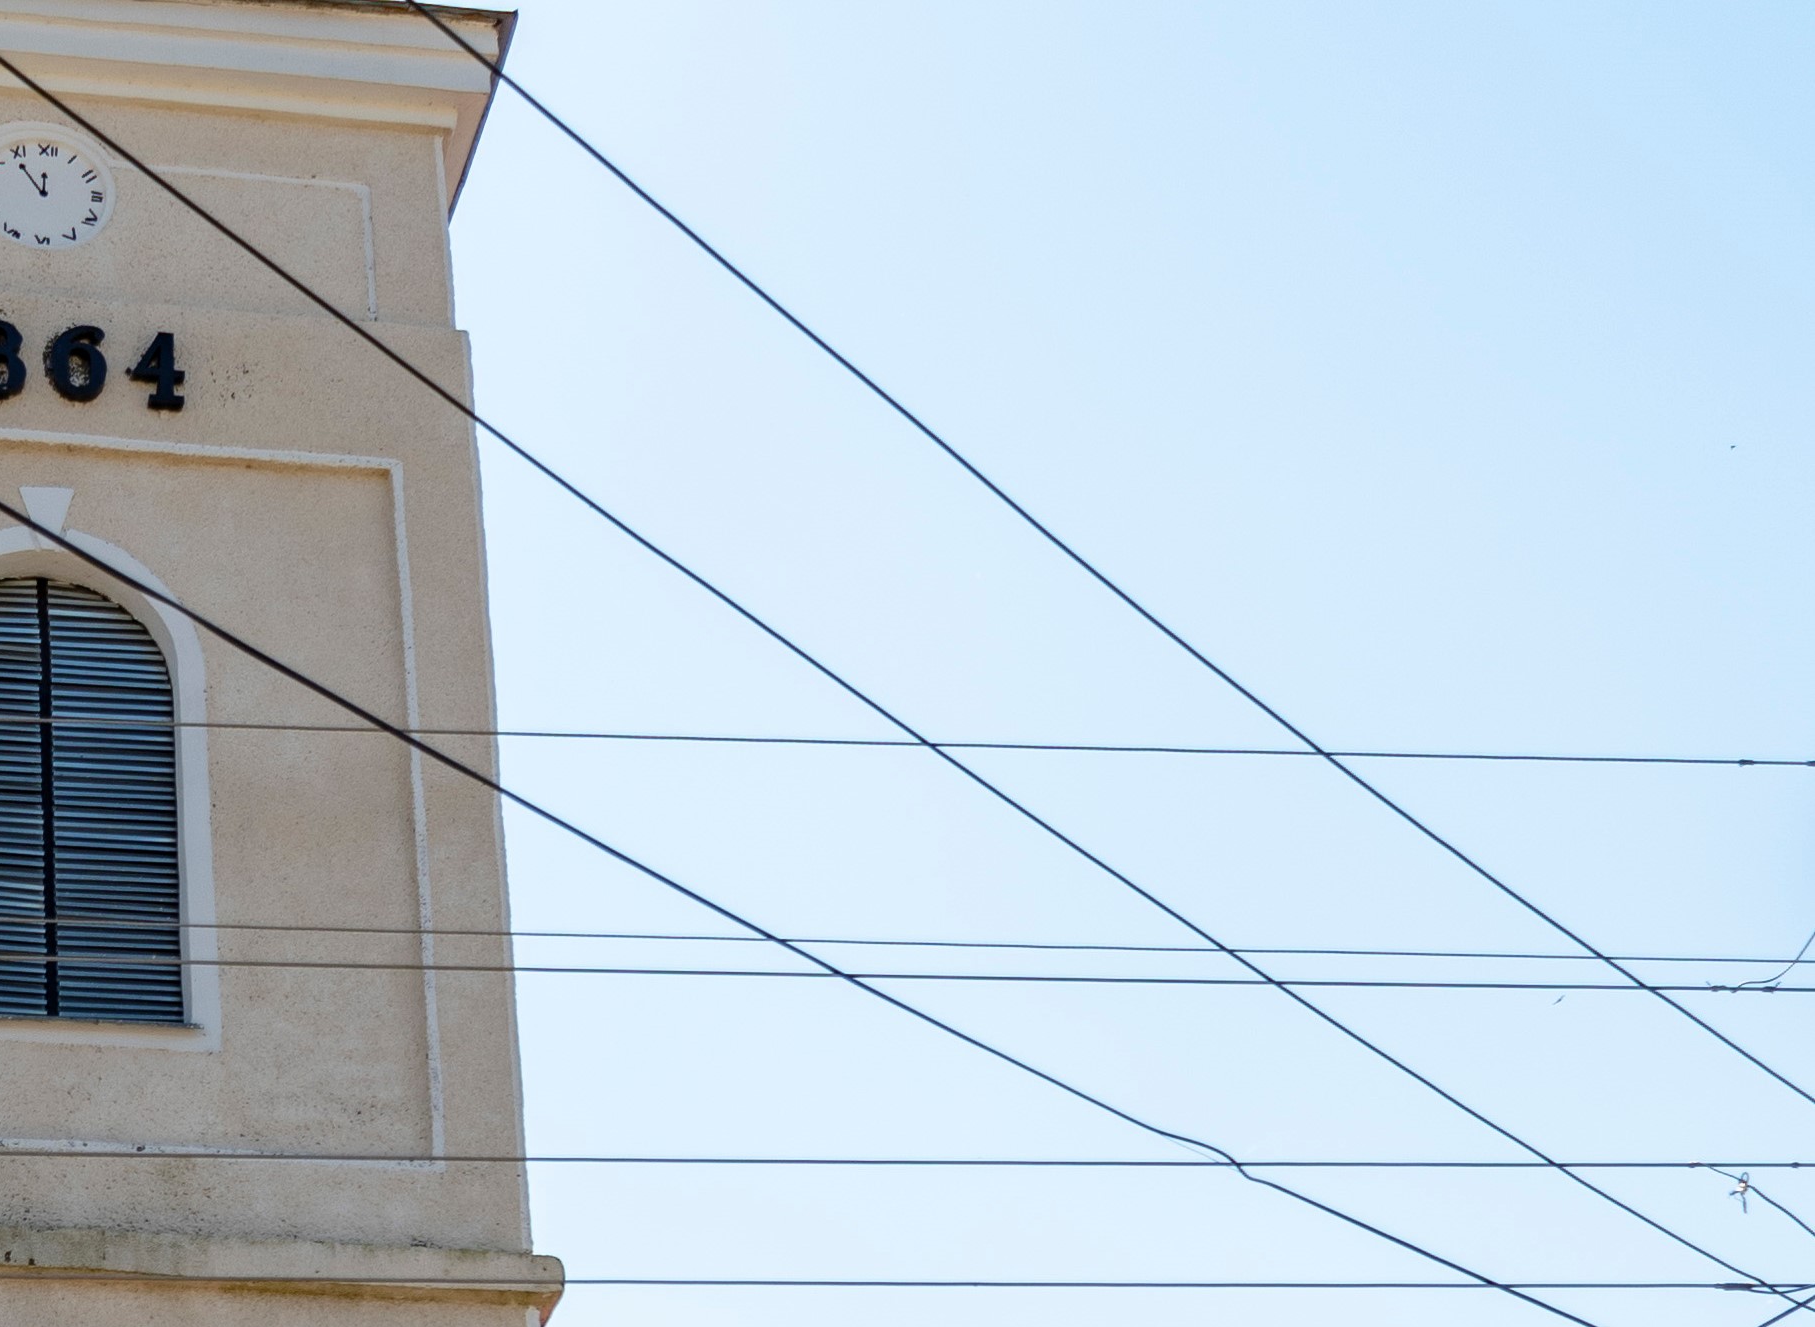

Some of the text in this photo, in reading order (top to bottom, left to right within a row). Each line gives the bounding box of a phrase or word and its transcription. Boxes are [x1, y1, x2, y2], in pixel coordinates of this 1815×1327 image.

[10, 145, 26, 159] XI
[38, 143, 59, 158] XII
[91, 190, 104, 203] III
[62, 227, 77, 241] V
